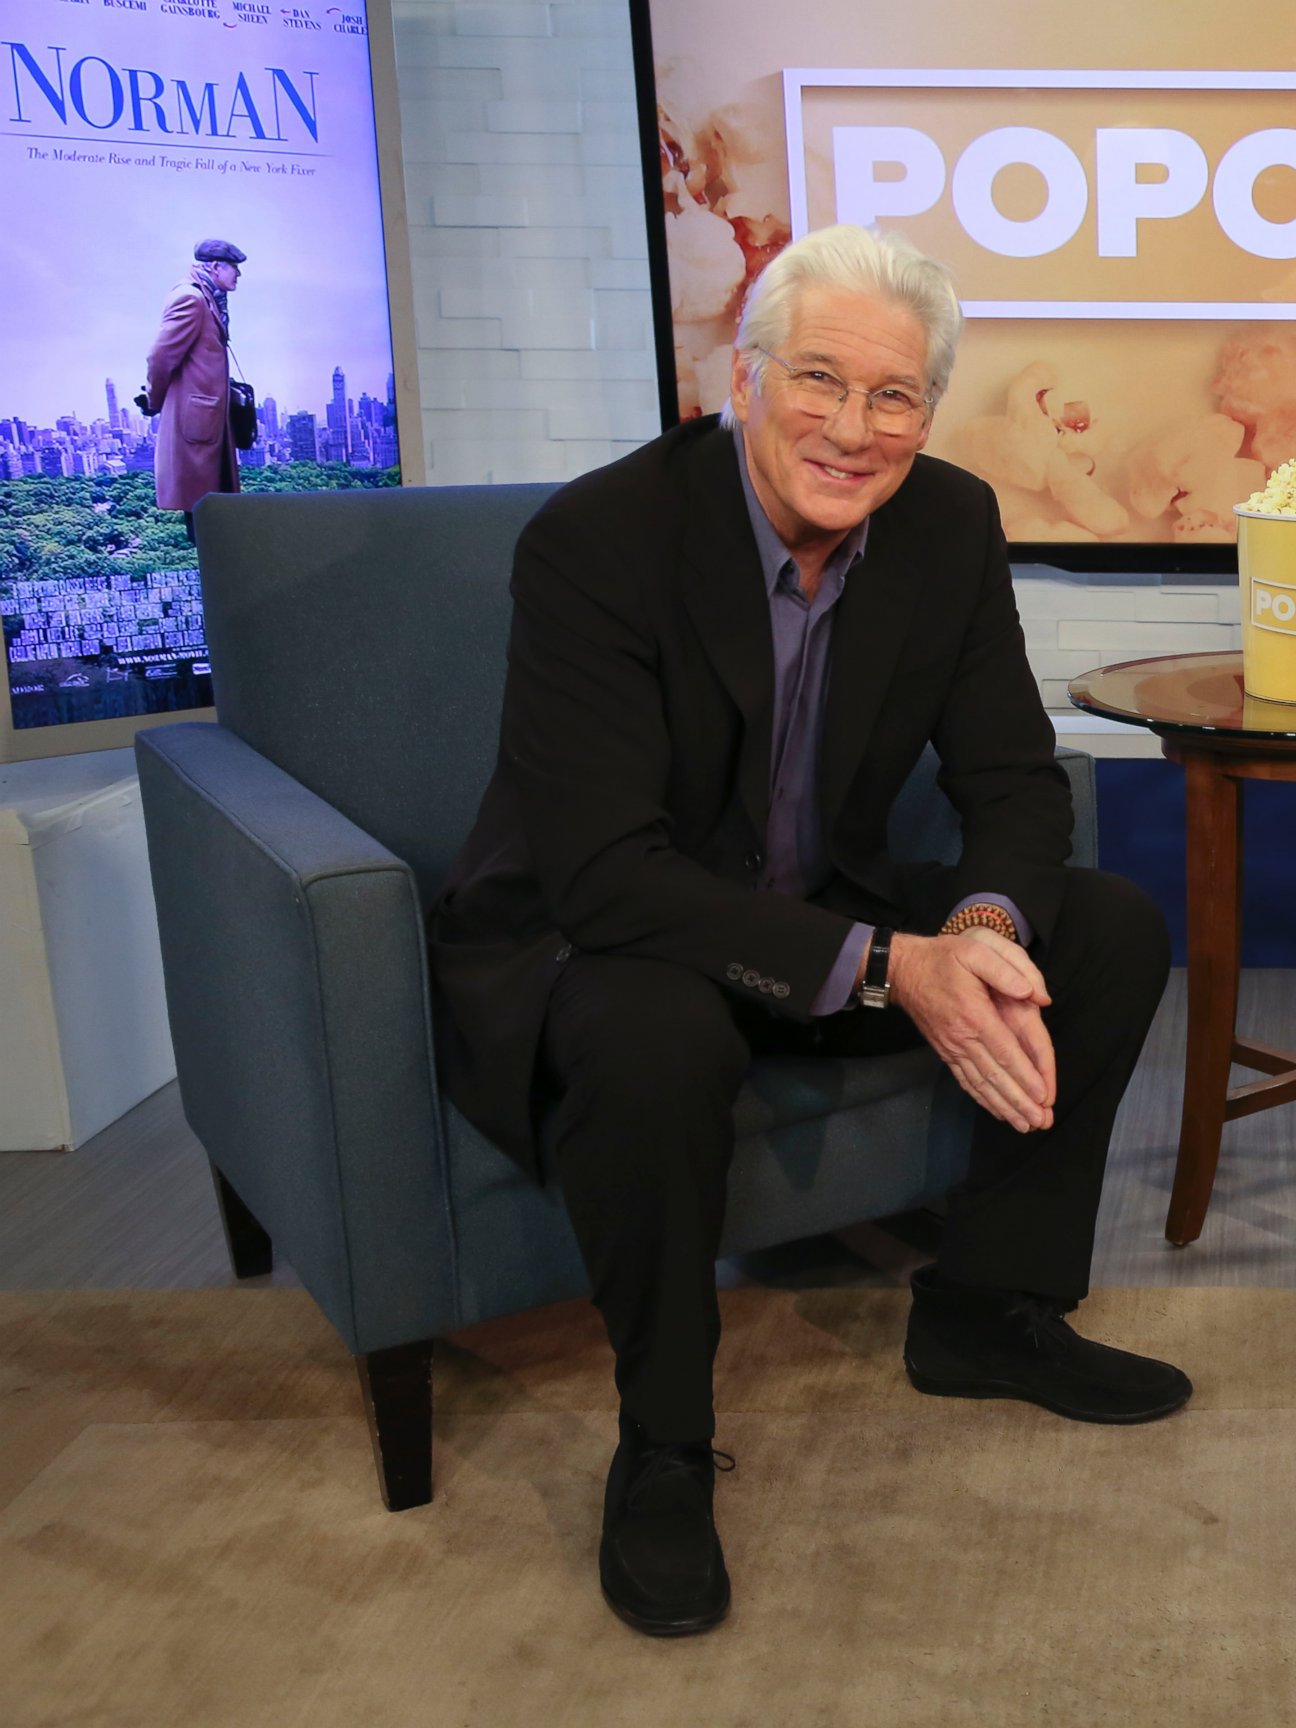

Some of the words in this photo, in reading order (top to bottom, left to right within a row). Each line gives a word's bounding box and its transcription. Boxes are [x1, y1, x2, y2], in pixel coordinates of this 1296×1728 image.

[103, 0, 148, 12] BUSCEMI
[160, 4, 221, 19] GAINSBOURG
[232, 1, 272, 15] MICHAEL
[238, 13, 269, 25] SHEEN
[292, 9, 311, 18] DAN
[341, 14, 363, 25] JOSH
[282, 18, 322, 30] STEVENS
[333, 25, 368, 35] CHARLE
[1, 41, 320, 144] NORMAN
[27, 147, 49, 160] The
[52, 149, 106, 164] Moderate
[108, 152, 132, 165] Rise
[134, 155, 156, 166] and
[159, 155, 193, 172] Tragic
[195, 158, 215, 170] Fall
[217, 160, 228, 174] of
[239, 160, 262, 173] New
[264, 162, 288, 175] York
[290, 163, 317, 176] Fixer
